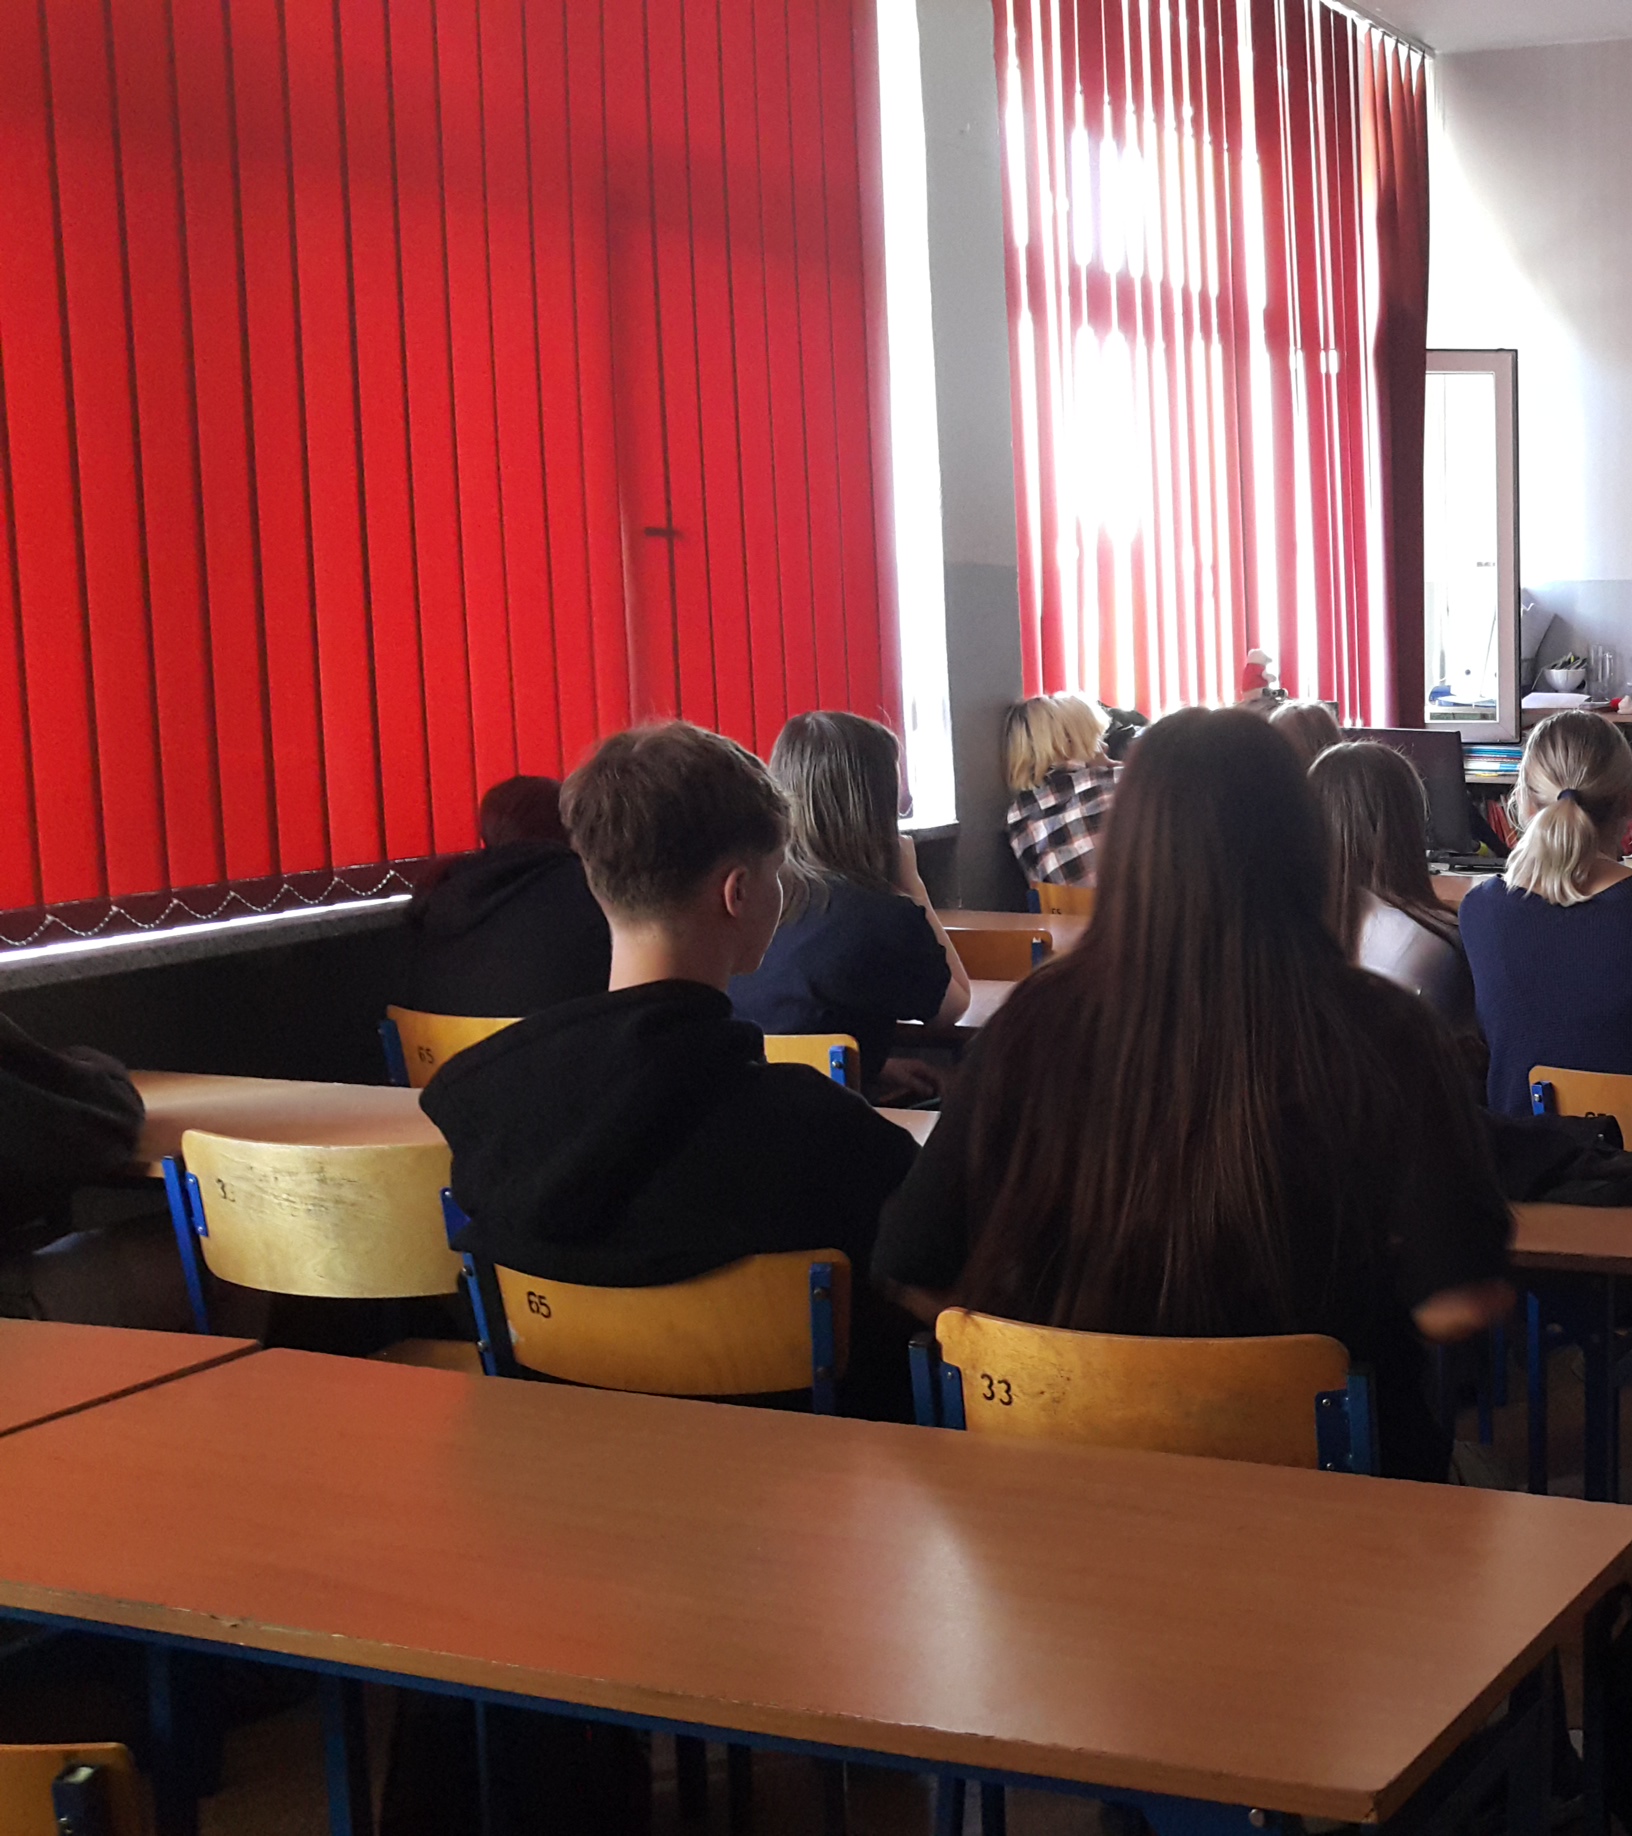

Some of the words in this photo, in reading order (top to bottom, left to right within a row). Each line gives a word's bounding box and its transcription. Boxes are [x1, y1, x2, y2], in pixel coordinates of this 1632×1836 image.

[418, 1046, 434, 1064] 65
[527, 1291, 552, 1319] 65
[980, 1373, 1013, 1406] 33
